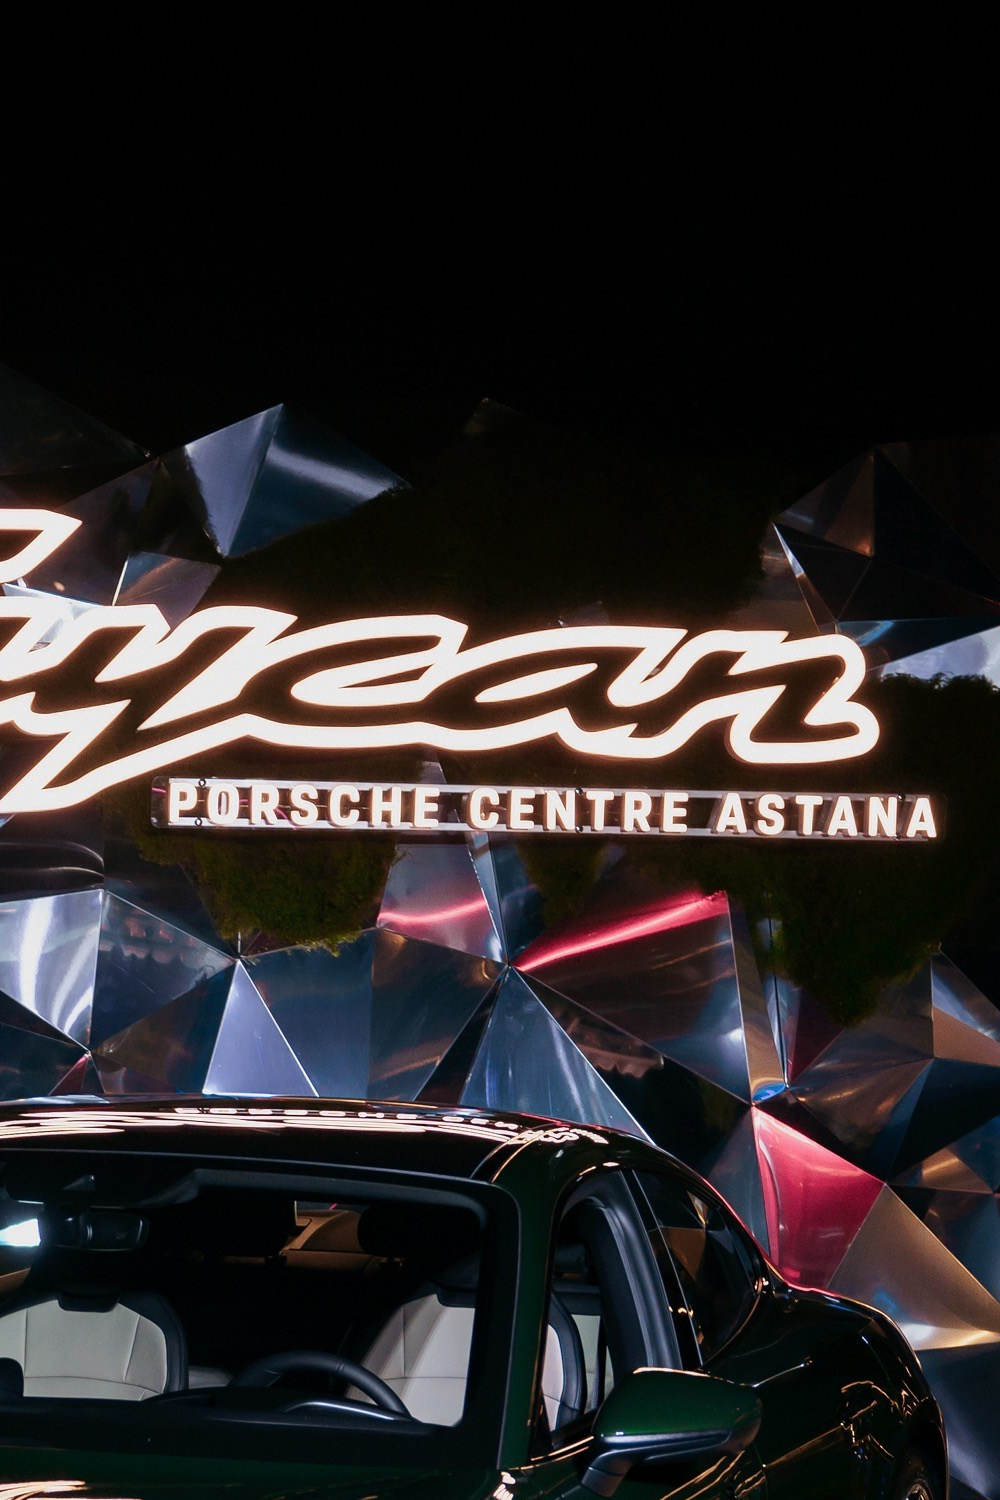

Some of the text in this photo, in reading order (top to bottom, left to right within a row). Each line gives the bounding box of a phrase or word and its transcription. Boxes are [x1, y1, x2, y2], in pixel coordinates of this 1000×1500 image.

[168, 778, 938, 838] PORSCHE CENTRE ASTANA
